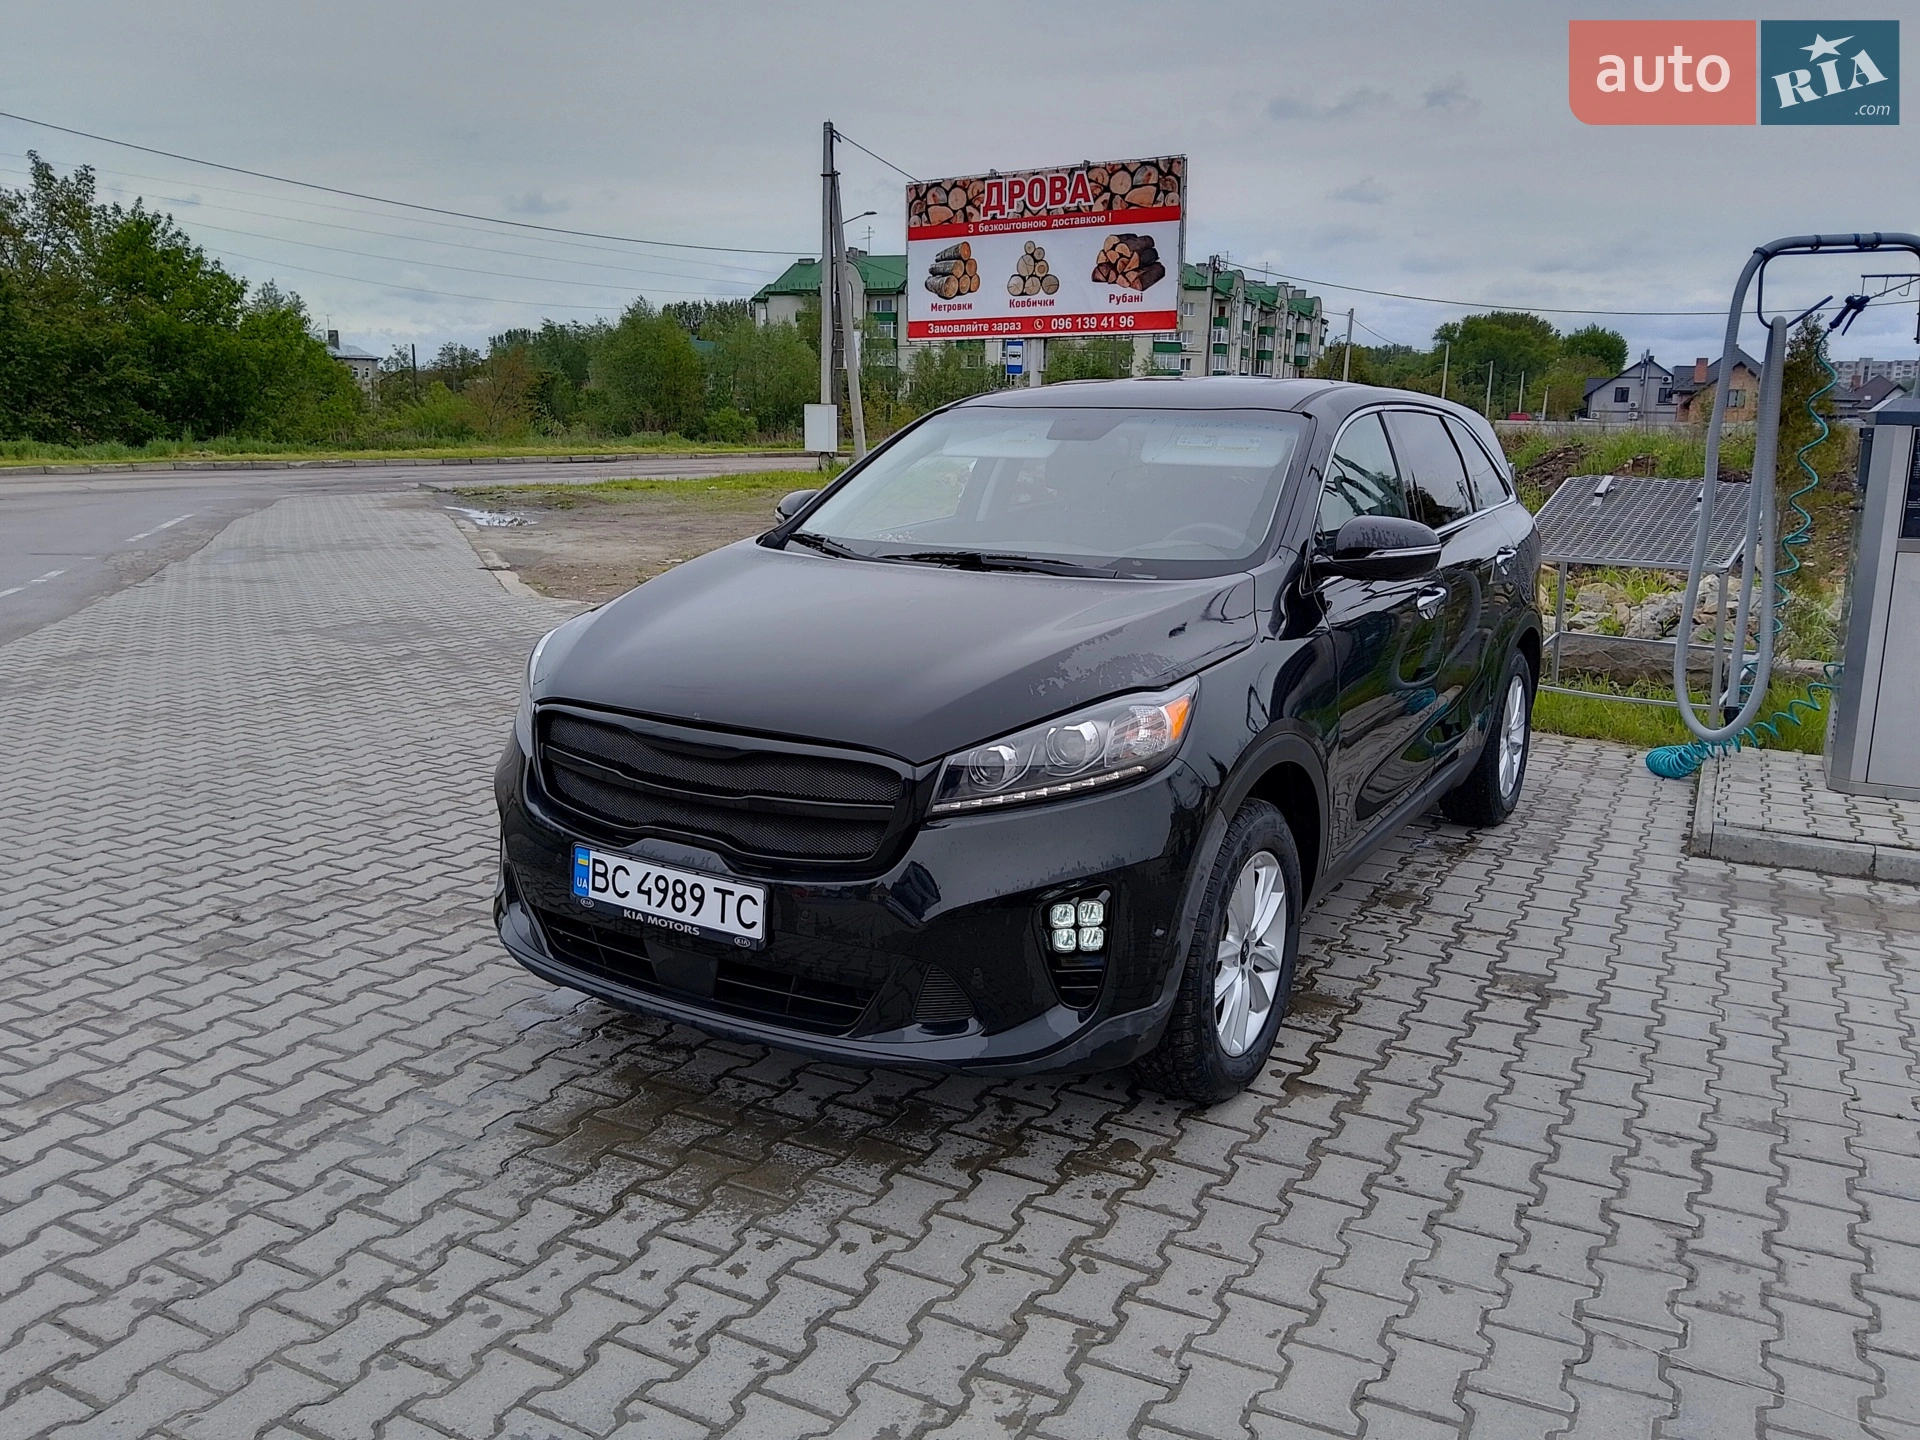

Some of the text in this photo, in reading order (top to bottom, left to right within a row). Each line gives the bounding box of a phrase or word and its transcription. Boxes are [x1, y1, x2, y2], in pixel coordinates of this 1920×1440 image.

[981, 170, 1094, 219] ДРОВА
[978, 219, 1047, 232] безкоштовною
[1051, 214, 1106, 228] доставкою
[930, 302, 973, 313] Метровки
[1009, 298, 1055, 308] Ковбички
[1108, 293, 1143, 305] Рубані
[927, 315, 1135, 334] Замовляйте зараз 096 139 41 96
[576, 876, 588, 889] UA
[591, 858, 759, 930] BC 4989 TC
[623, 908, 700, 936] KIA MOTORS
